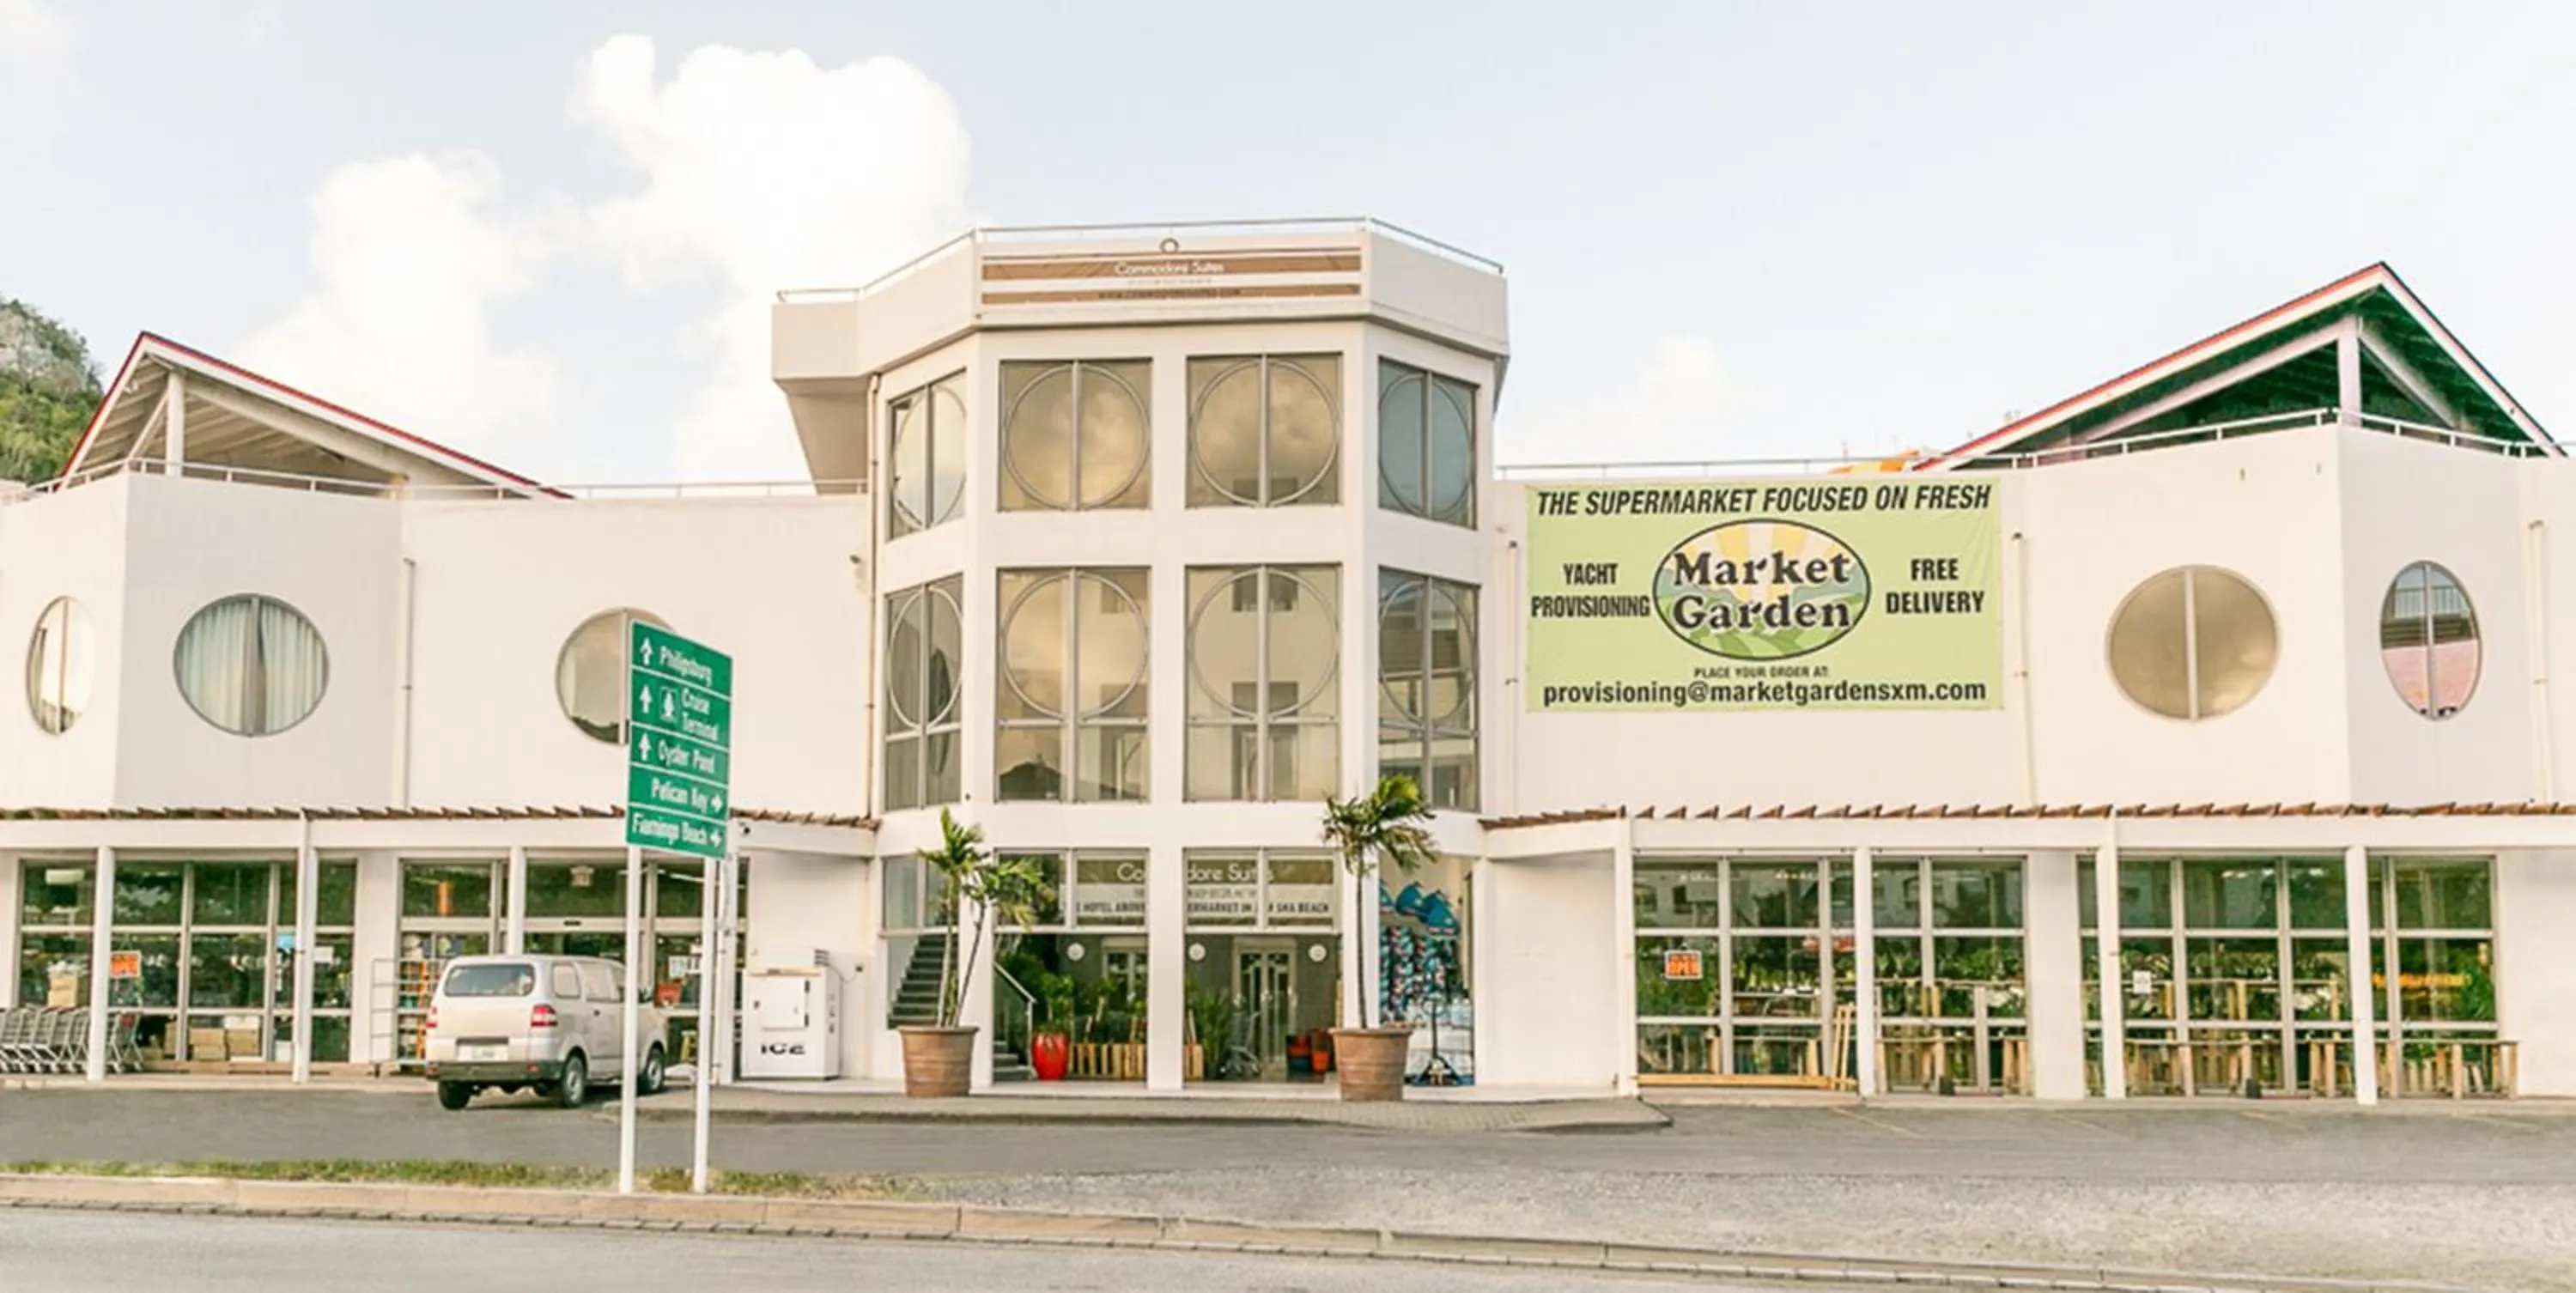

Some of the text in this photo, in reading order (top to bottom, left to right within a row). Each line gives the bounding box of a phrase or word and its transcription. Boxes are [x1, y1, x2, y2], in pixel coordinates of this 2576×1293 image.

[1538, 484, 1992, 515] THE SUPERMARKET FOCUSED ON FRESH
[1563, 563, 1619, 585] YACHT
[1674, 550, 1850, 586] Market
[1911, 558, 1959, 580] FREE
[1531, 595, 1650, 617] PROVISIONING
[1674, 595, 1850, 628] Garden
[1886, 591, 1984, 614] DELIVERY
[1693, 667, 1730, 678] PLACE
[1735, 666, 1766, 678] YOUR
[1770, 666, 1809, 677] ORDER
[1544, 680, 1986, 707] provisioning@marketgardensxm.com
[761, 1041, 805, 1055] ICE
